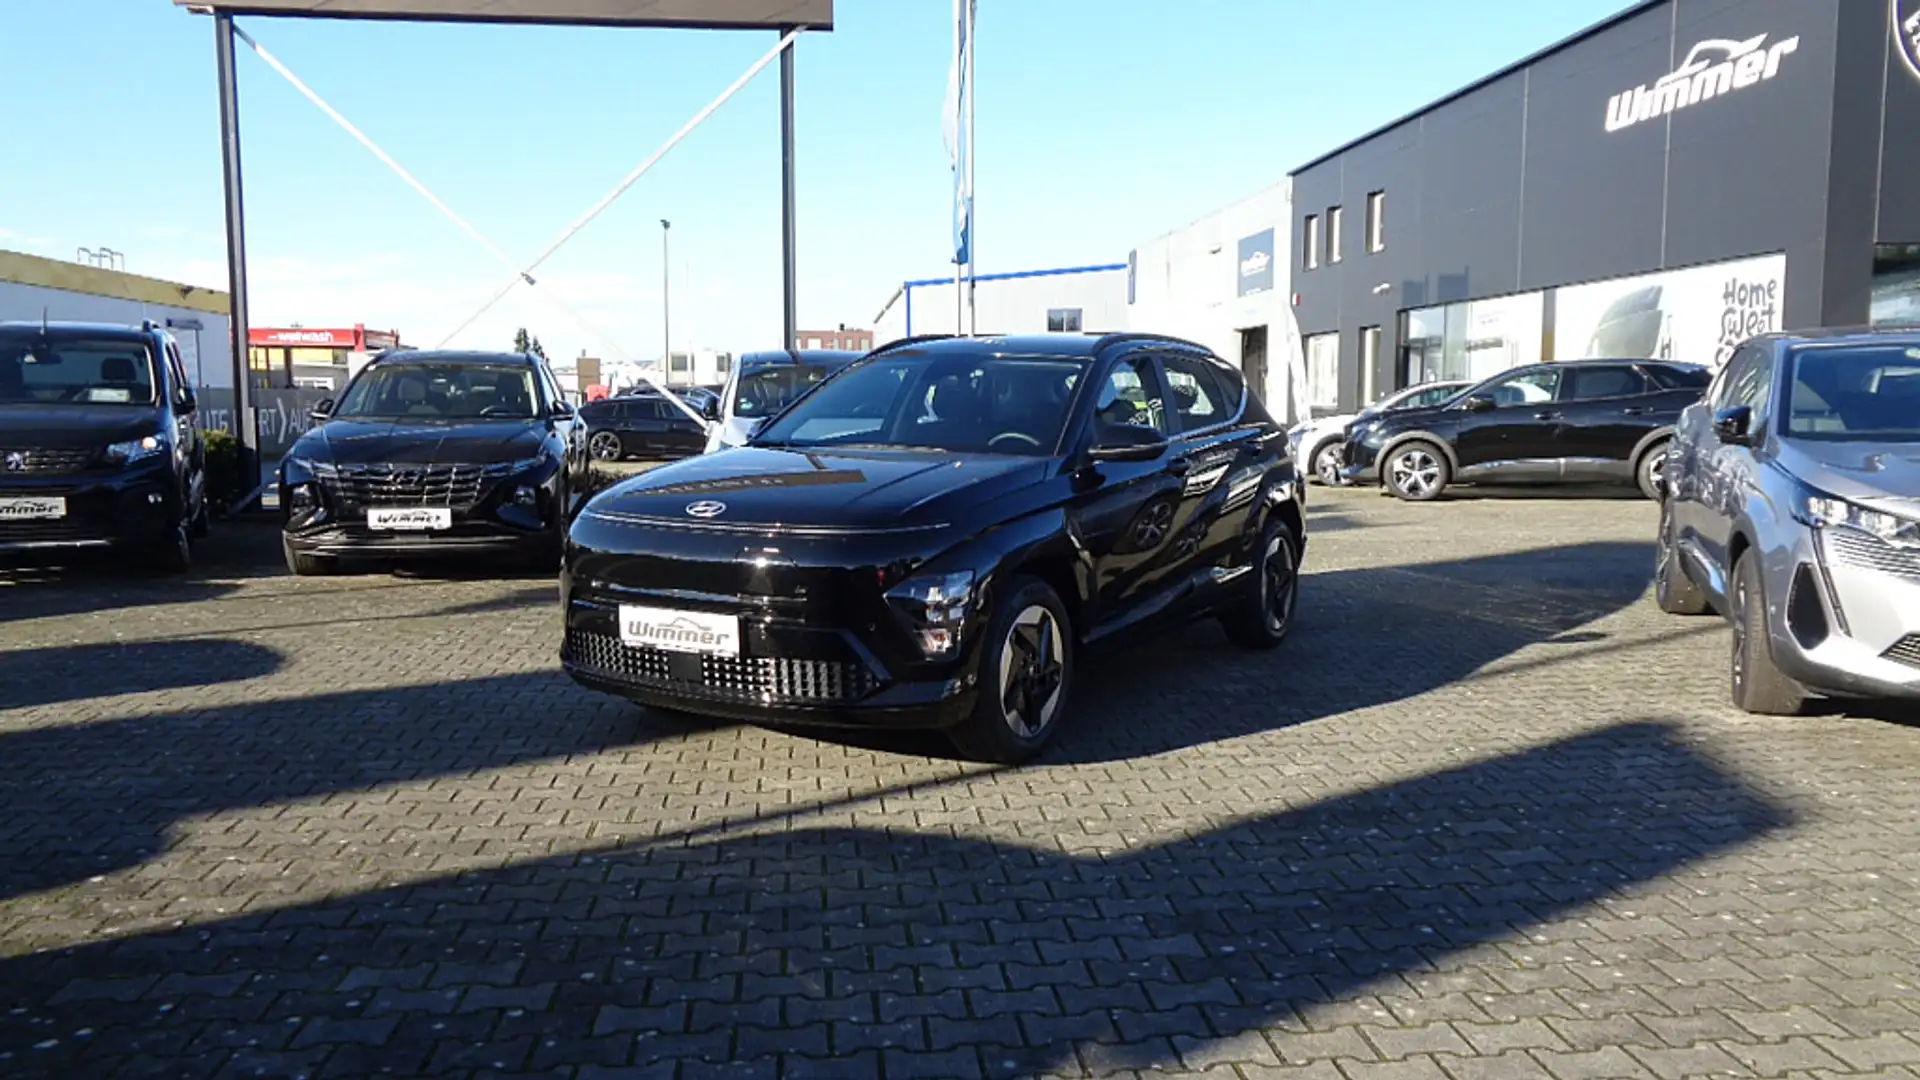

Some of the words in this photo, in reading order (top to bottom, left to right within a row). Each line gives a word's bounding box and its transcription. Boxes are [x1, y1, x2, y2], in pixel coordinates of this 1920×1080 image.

[1605, 36, 1799, 132] Wimmer
[1723, 278, 1777, 308] Home
[628, 620, 731, 645] Wimmer
